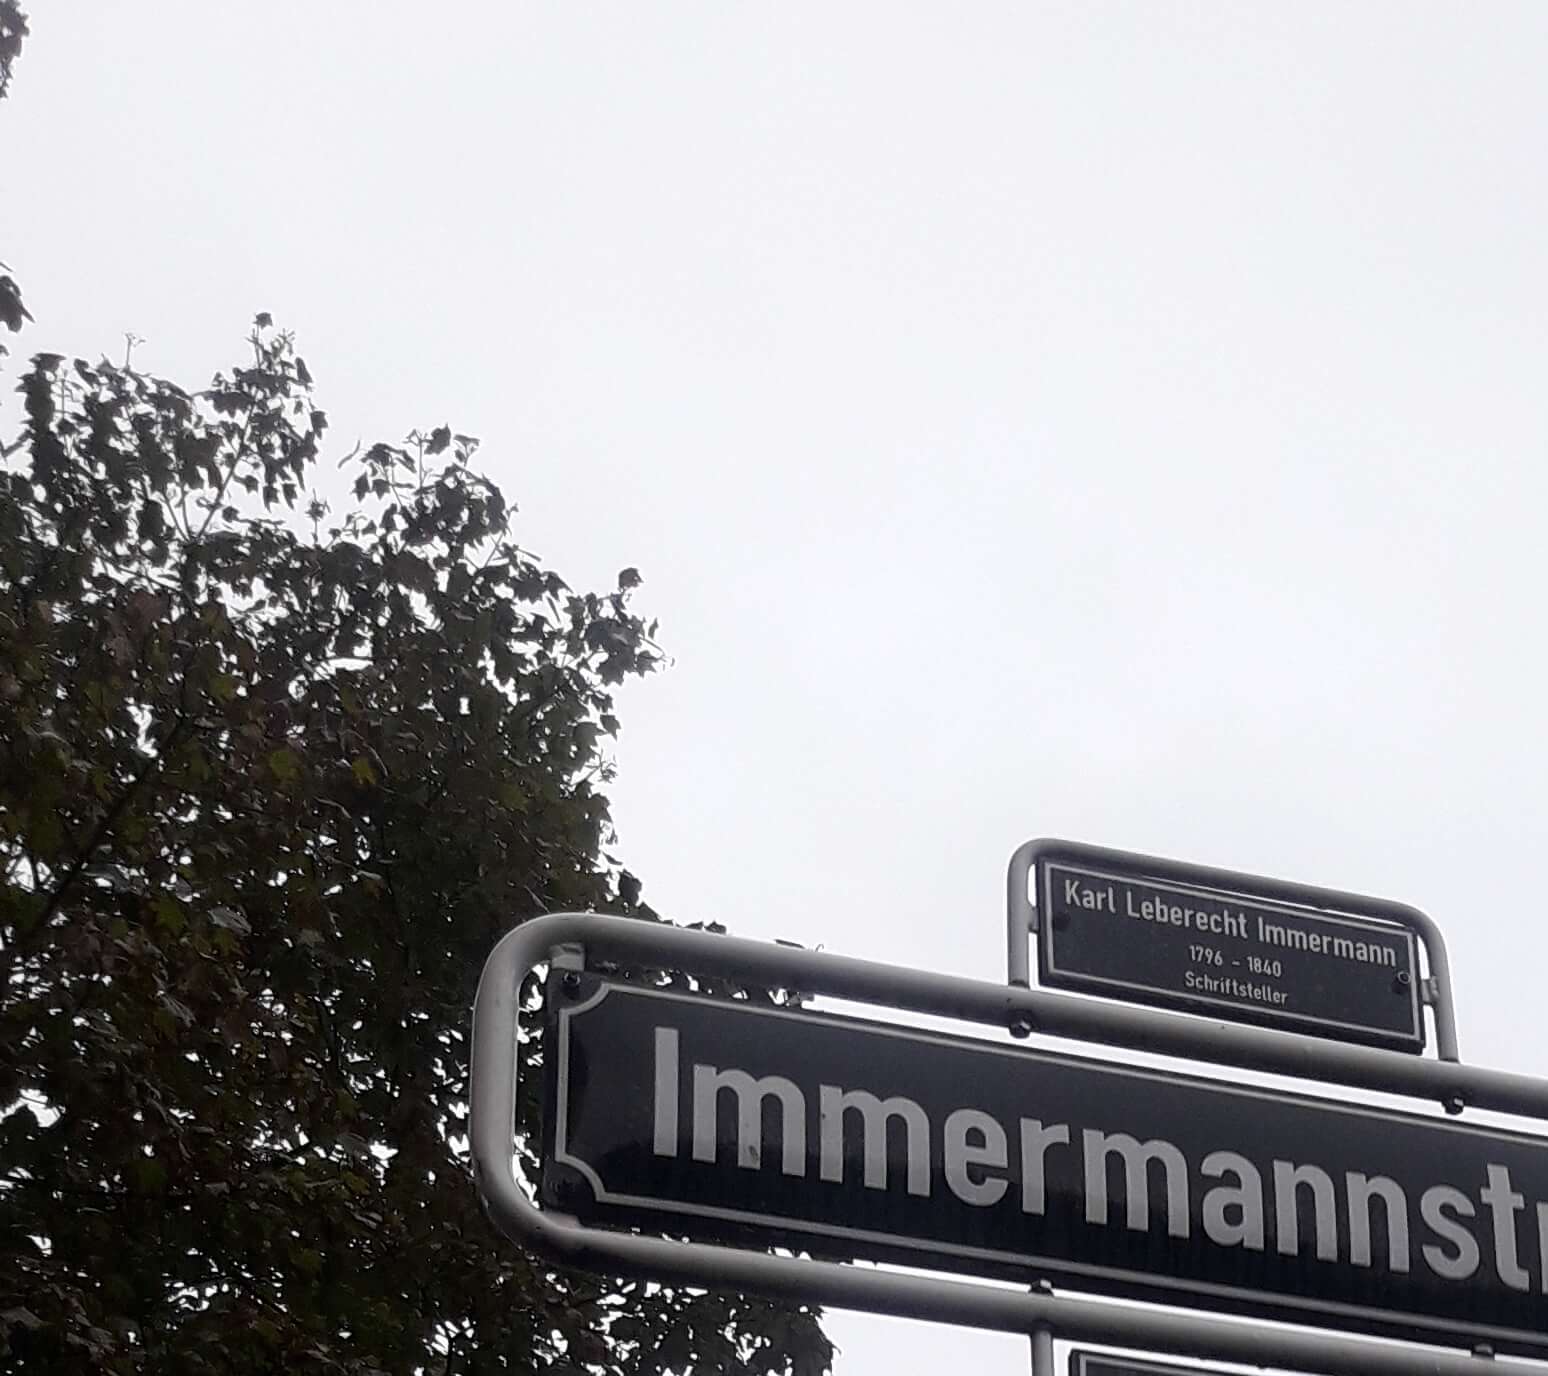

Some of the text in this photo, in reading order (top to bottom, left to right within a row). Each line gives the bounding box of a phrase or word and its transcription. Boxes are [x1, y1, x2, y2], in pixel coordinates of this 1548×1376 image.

[1064, 879, 1397, 968] Karl Leberecht Immermann
[1189, 945, 1223, 968] 1796
[1247, 956, 1282, 978] 1840
[1185, 971, 1288, 1006] Schriftsteller
